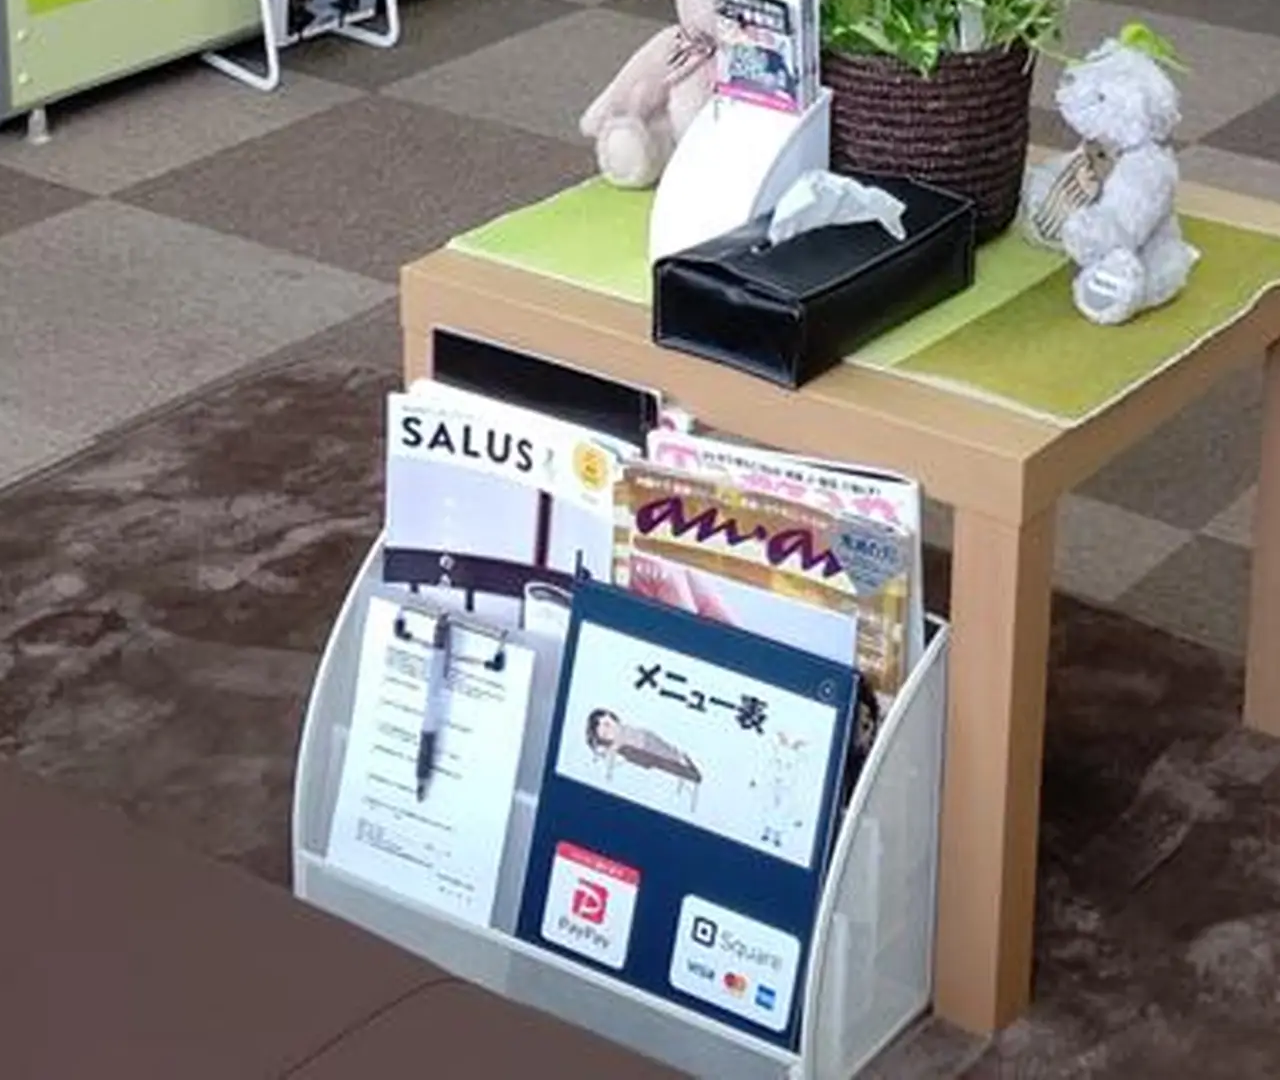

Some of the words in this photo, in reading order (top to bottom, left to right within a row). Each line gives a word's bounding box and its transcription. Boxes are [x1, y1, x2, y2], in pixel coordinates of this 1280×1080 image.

[401, 416, 534, 473] SALUS
[634, 663, 768, 736] メニュー表
[556, 914, 612, 951] PayPay
[720, 928, 785, 970] Square
